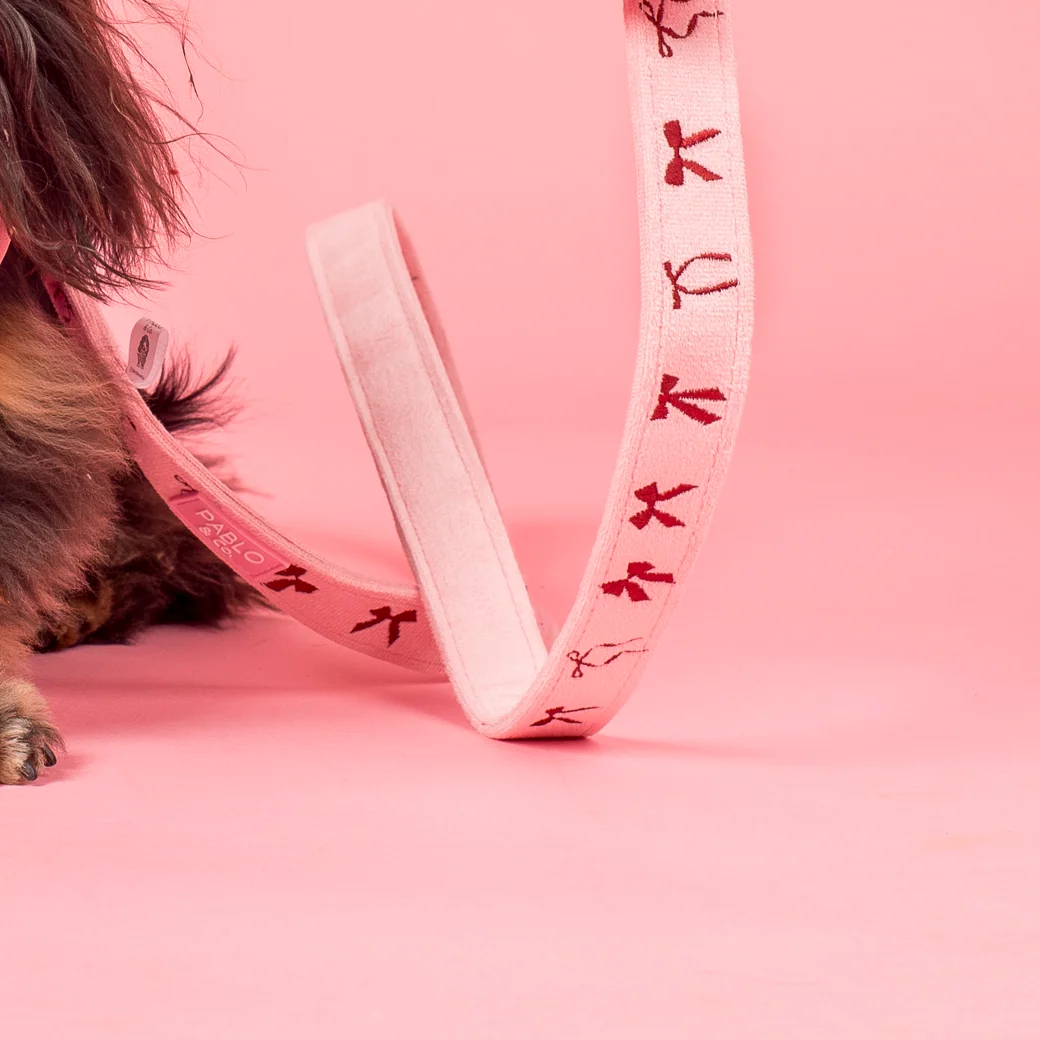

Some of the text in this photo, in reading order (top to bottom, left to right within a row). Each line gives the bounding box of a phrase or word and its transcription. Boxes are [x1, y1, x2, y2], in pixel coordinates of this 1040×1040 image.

[195, 509, 265, 565] PABLO
[198, 526, 233, 558] & Co.
